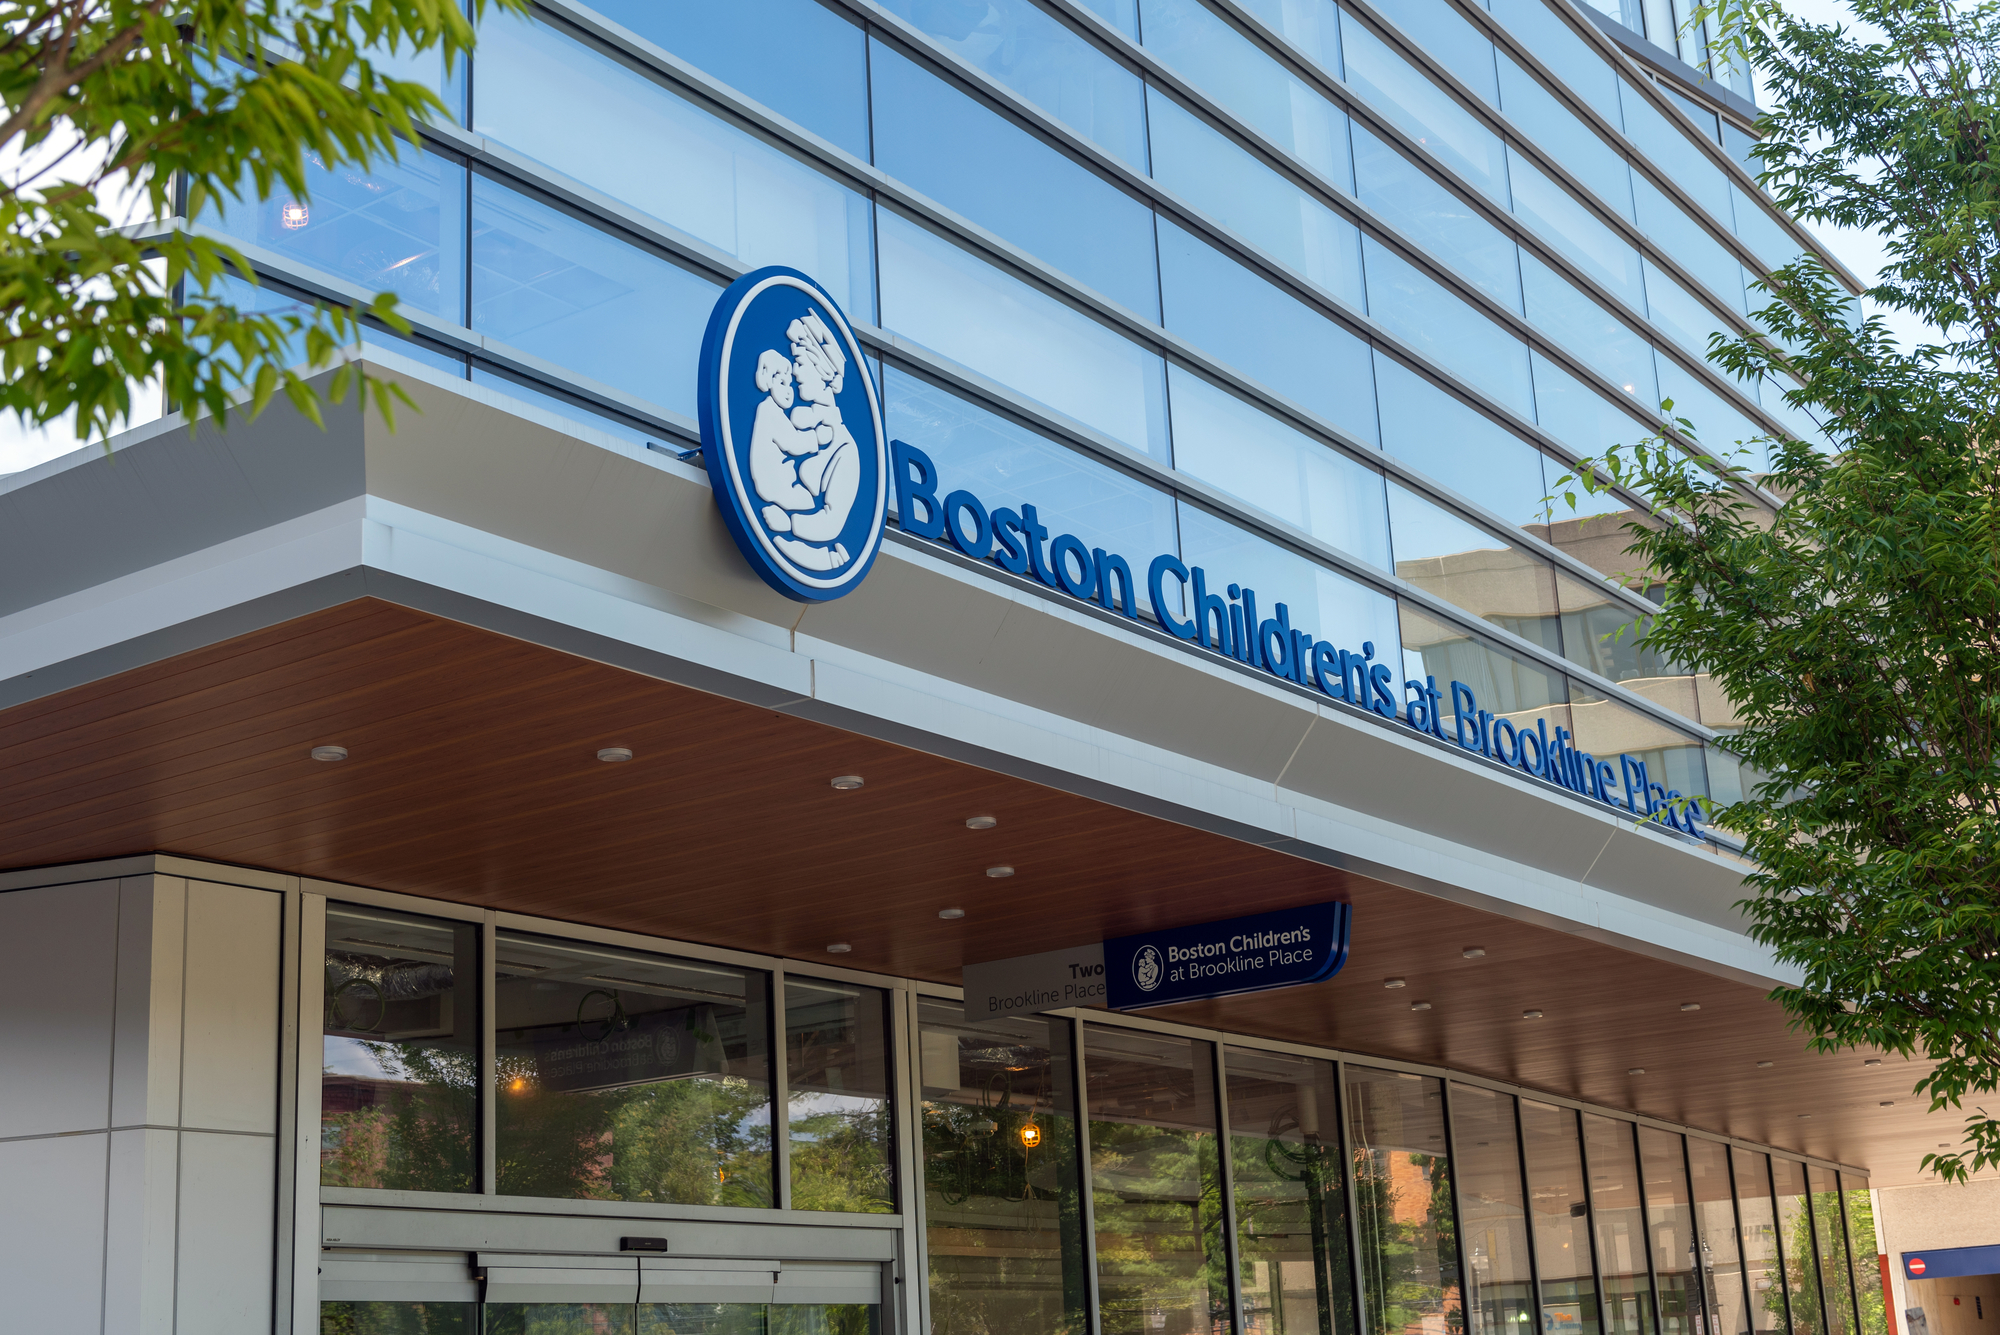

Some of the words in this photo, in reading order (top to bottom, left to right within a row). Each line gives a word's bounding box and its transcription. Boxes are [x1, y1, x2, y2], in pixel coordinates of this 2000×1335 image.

[890, 439, 1138, 620] Boston
[1147, 553, 1398, 719] Children's
[1404, 675, 1449, 740] at
[1450, 680, 1621, 806] Brookline
[1619, 753, 1706, 840] Place
[1168, 942, 1226, 962] Boston
[1230, 926, 1311, 952] Children's
[1069, 963, 1105, 979] Two
[1170, 966, 1185, 982] at
[1190, 955, 1264, 979] Brookline
[1269, 948, 1312, 967] Place
[988, 988, 1060, 1012] Brookline
[1065, 982, 1106, 1000] Place
